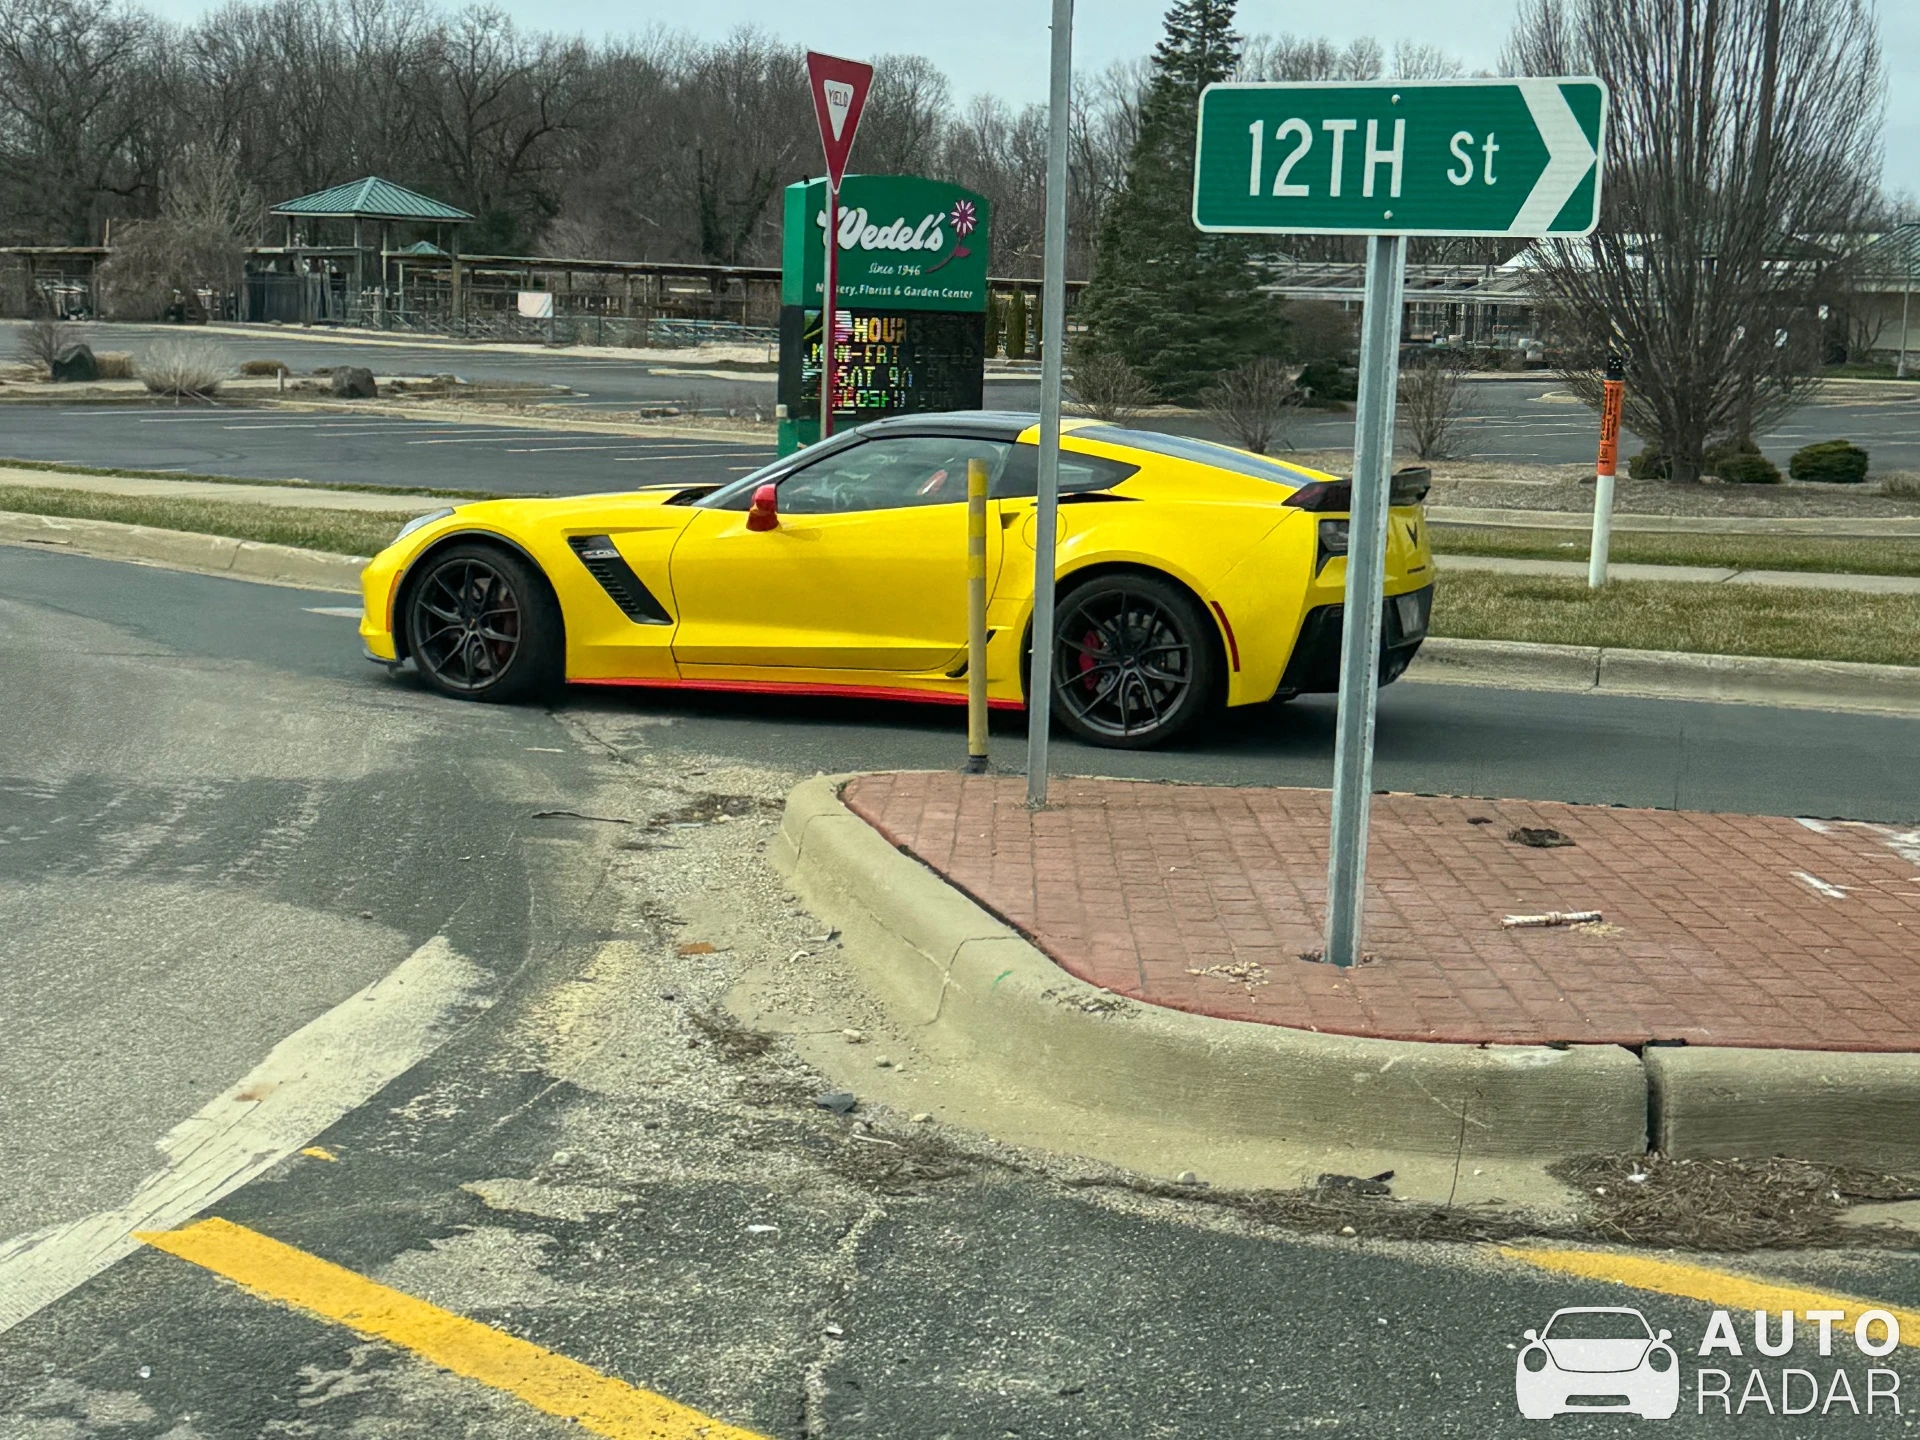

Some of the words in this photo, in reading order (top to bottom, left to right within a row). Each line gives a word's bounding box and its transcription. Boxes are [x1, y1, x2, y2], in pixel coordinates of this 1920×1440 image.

[1248, 117, 1406, 198] 12TH
[1446, 131, 1500, 186] St
[816, 206, 946, 252] Wedel's
[868, 262, 895, 275] Since
[897, 264, 922, 276] 1946
[815, 282, 858, 297] Nsery,
[859, 284, 892, 297] Florist
[894, 286, 902, 296] &
[904, 286, 940, 298] Garden
[942, 288, 974, 299] Center
